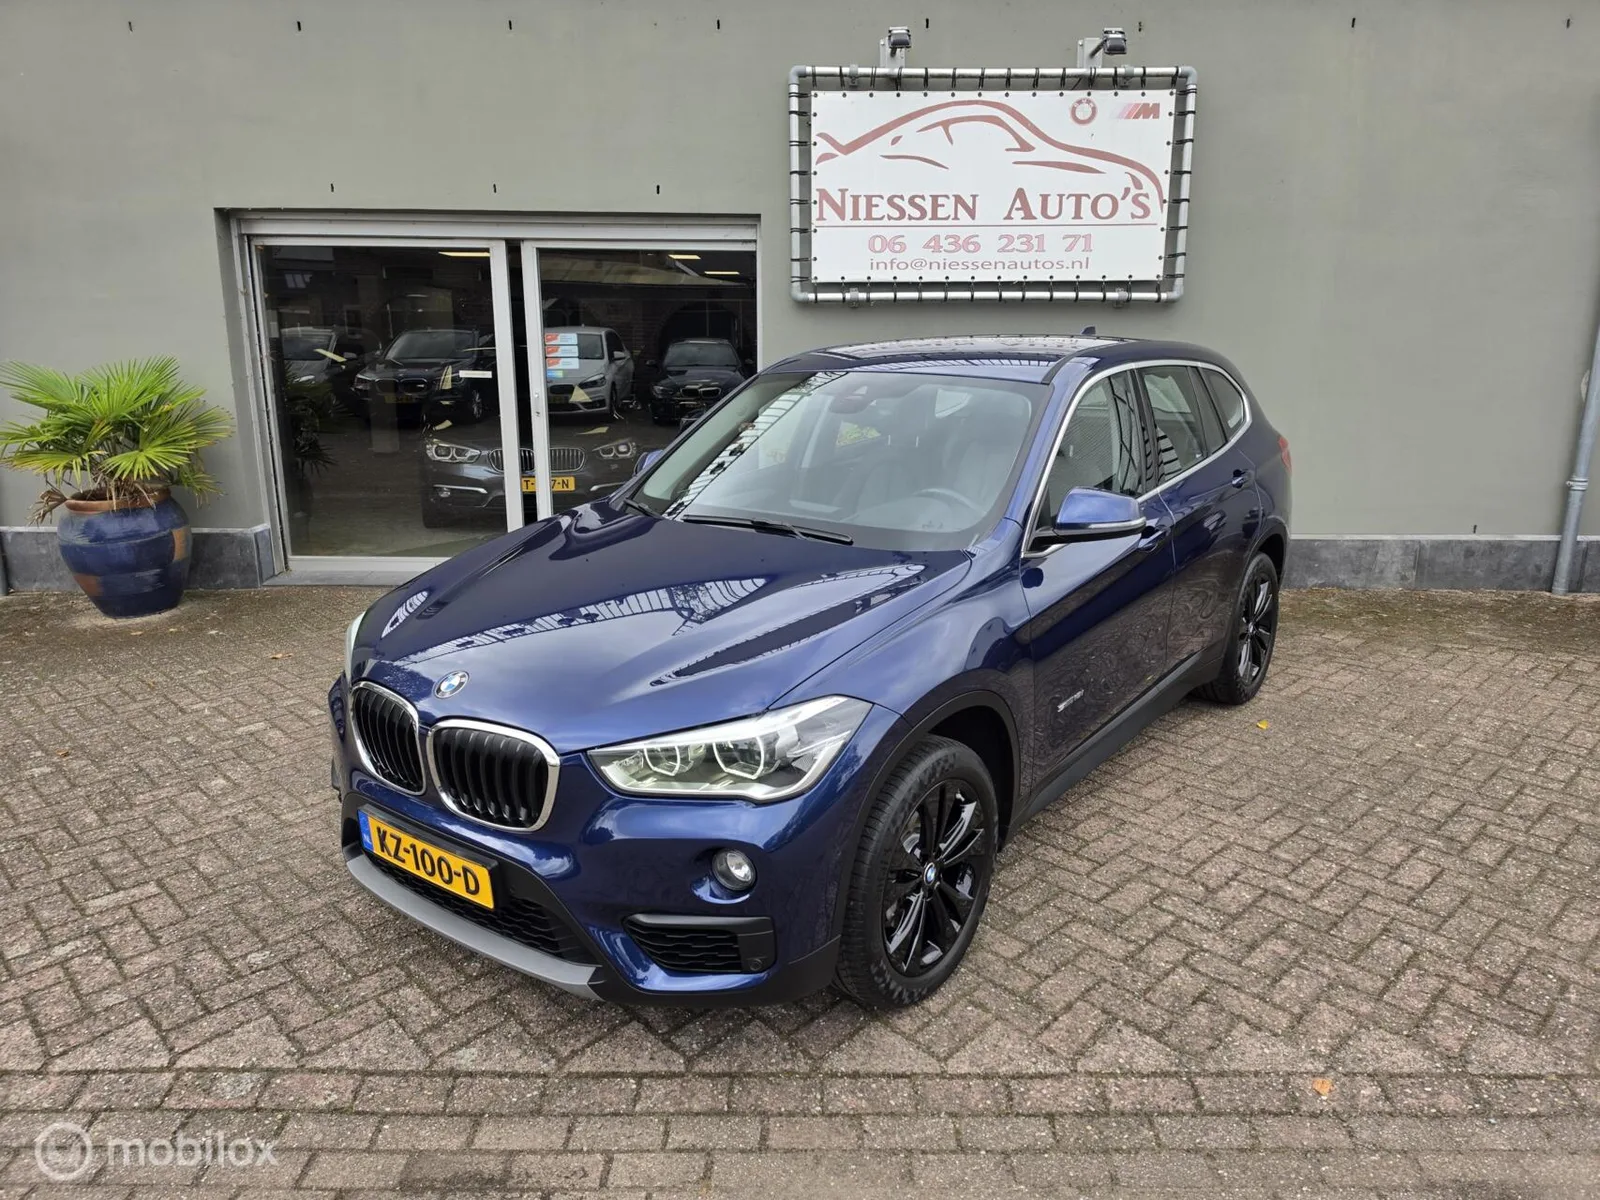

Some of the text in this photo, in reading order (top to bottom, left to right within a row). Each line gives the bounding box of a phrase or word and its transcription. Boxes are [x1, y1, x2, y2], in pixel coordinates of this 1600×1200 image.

[815, 186, 1151, 222] NIESSEN AUTO'S
[868, 233, 1093, 254] 06 436 231 71
[869, 256, 1090, 271] info@niessenautos.nl
[376, 825, 481, 896] KZ-100-D
